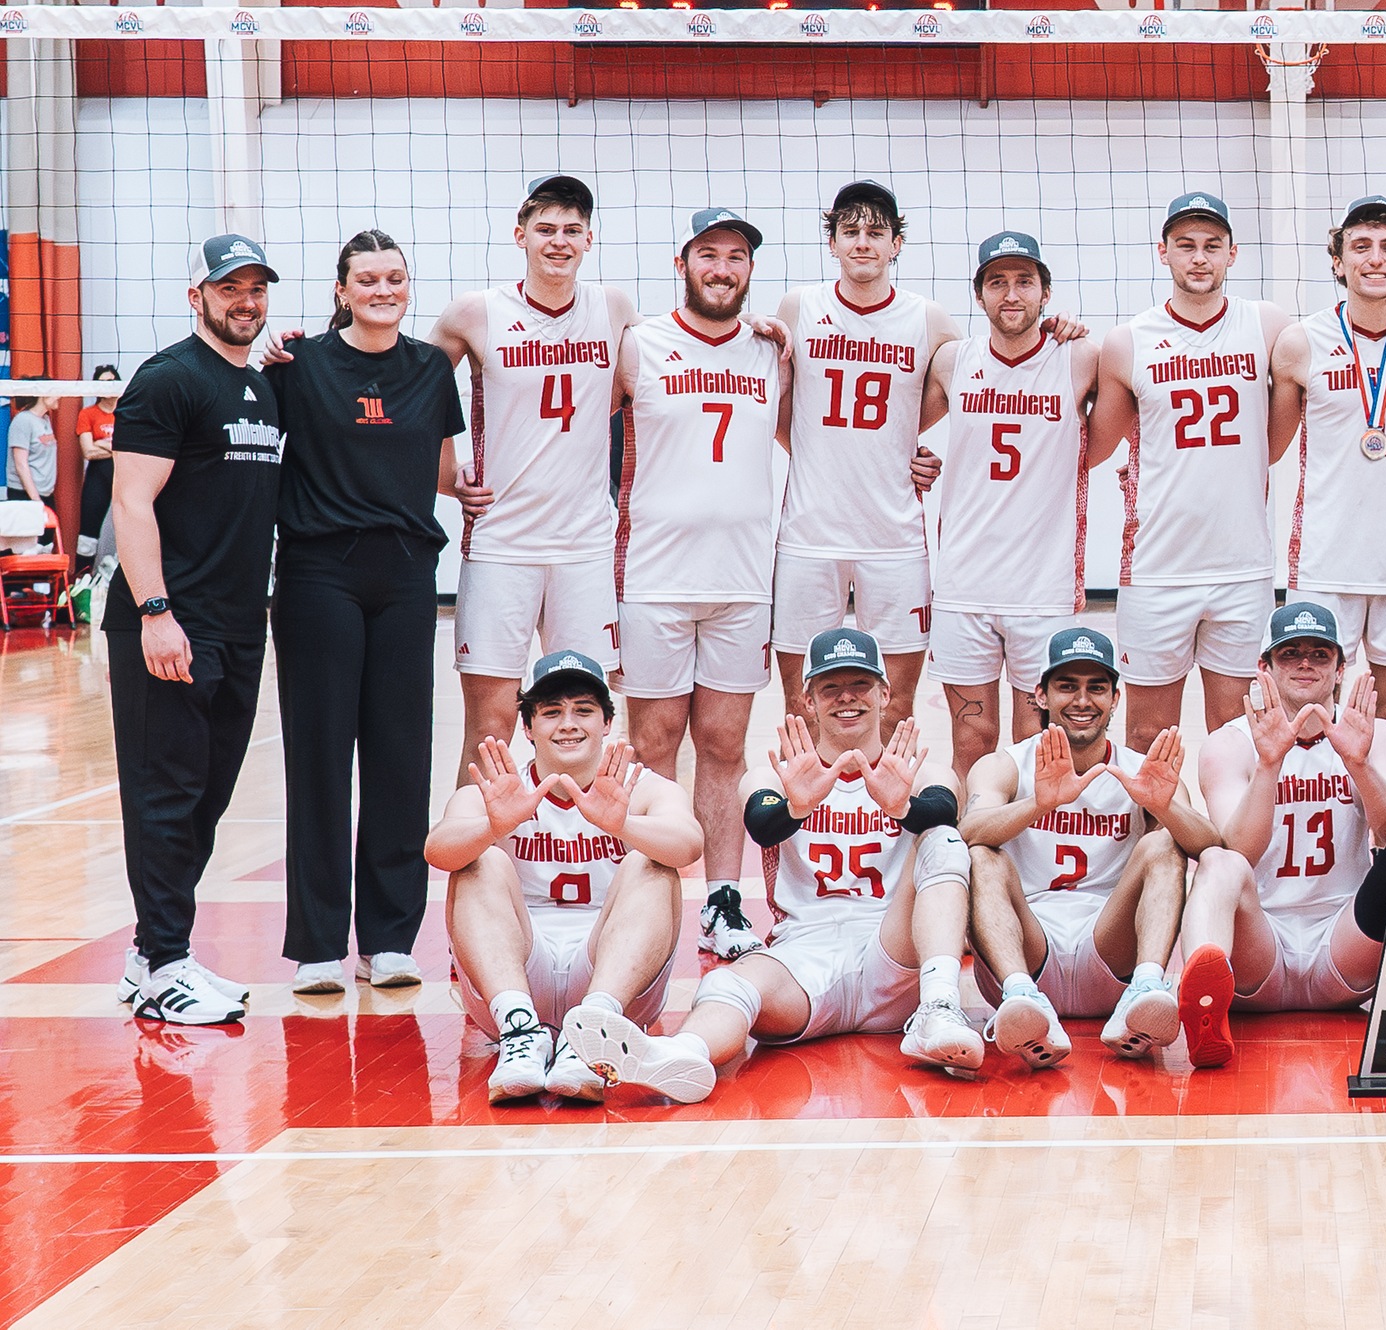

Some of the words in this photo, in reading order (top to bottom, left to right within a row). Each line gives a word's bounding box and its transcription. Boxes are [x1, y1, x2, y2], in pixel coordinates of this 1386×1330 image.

[0, 22, 27, 30] MCVL
[116, 22, 143, 30] MCVL
[231, 22, 258, 30] MCVL
[345, 22, 372, 30] MCVL
[460, 23, 486, 31] MCVL
[575, 25, 601, 33] MCVL
[688, 25, 715, 33] MCVL
[800, 24, 827, 33] MCVL
[914, 25, 940, 33] MCVL
[1027, 25, 1053, 34] MCVL
[1139, 25, 1166, 34] MCVL
[1251, 26, 1277, 35] MCVL
[540, 374, 576, 433] 4
[822, 369, 891, 430] 18
[1170, 385, 1240, 449] 22
[702, 403, 733, 463] 7
[990, 423, 1021, 481] 5
[1276, 809, 1336, 879] 13
[809, 843, 886, 899] 25
[1049, 843, 1088, 891] 2
